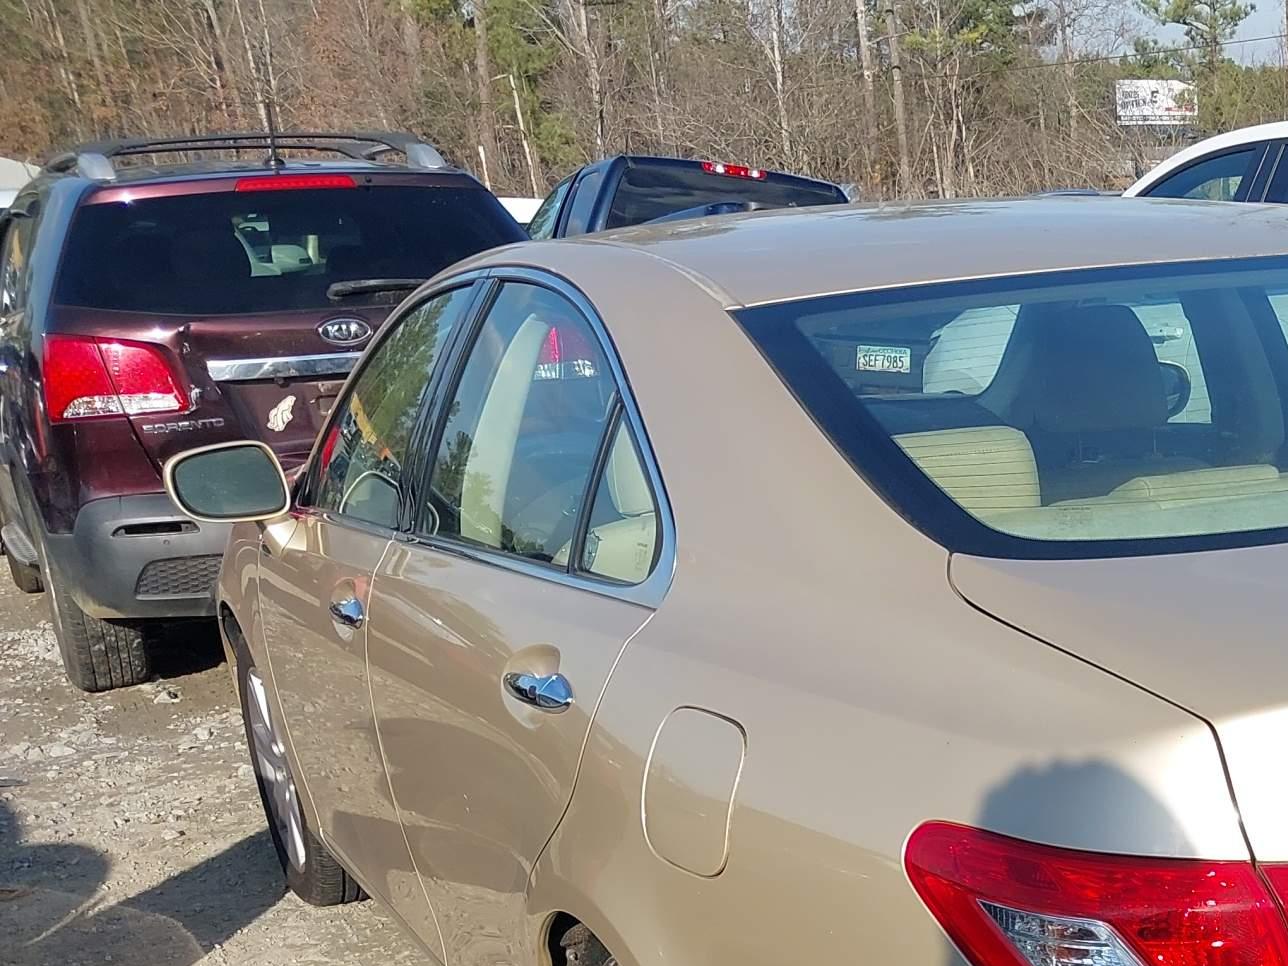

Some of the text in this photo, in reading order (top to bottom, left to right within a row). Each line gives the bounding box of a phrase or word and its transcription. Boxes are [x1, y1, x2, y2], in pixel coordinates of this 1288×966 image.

[326, 322, 361, 340] KIA
[862, 354, 904, 369] SEF7985
[142, 417, 225, 434] SORENTO
